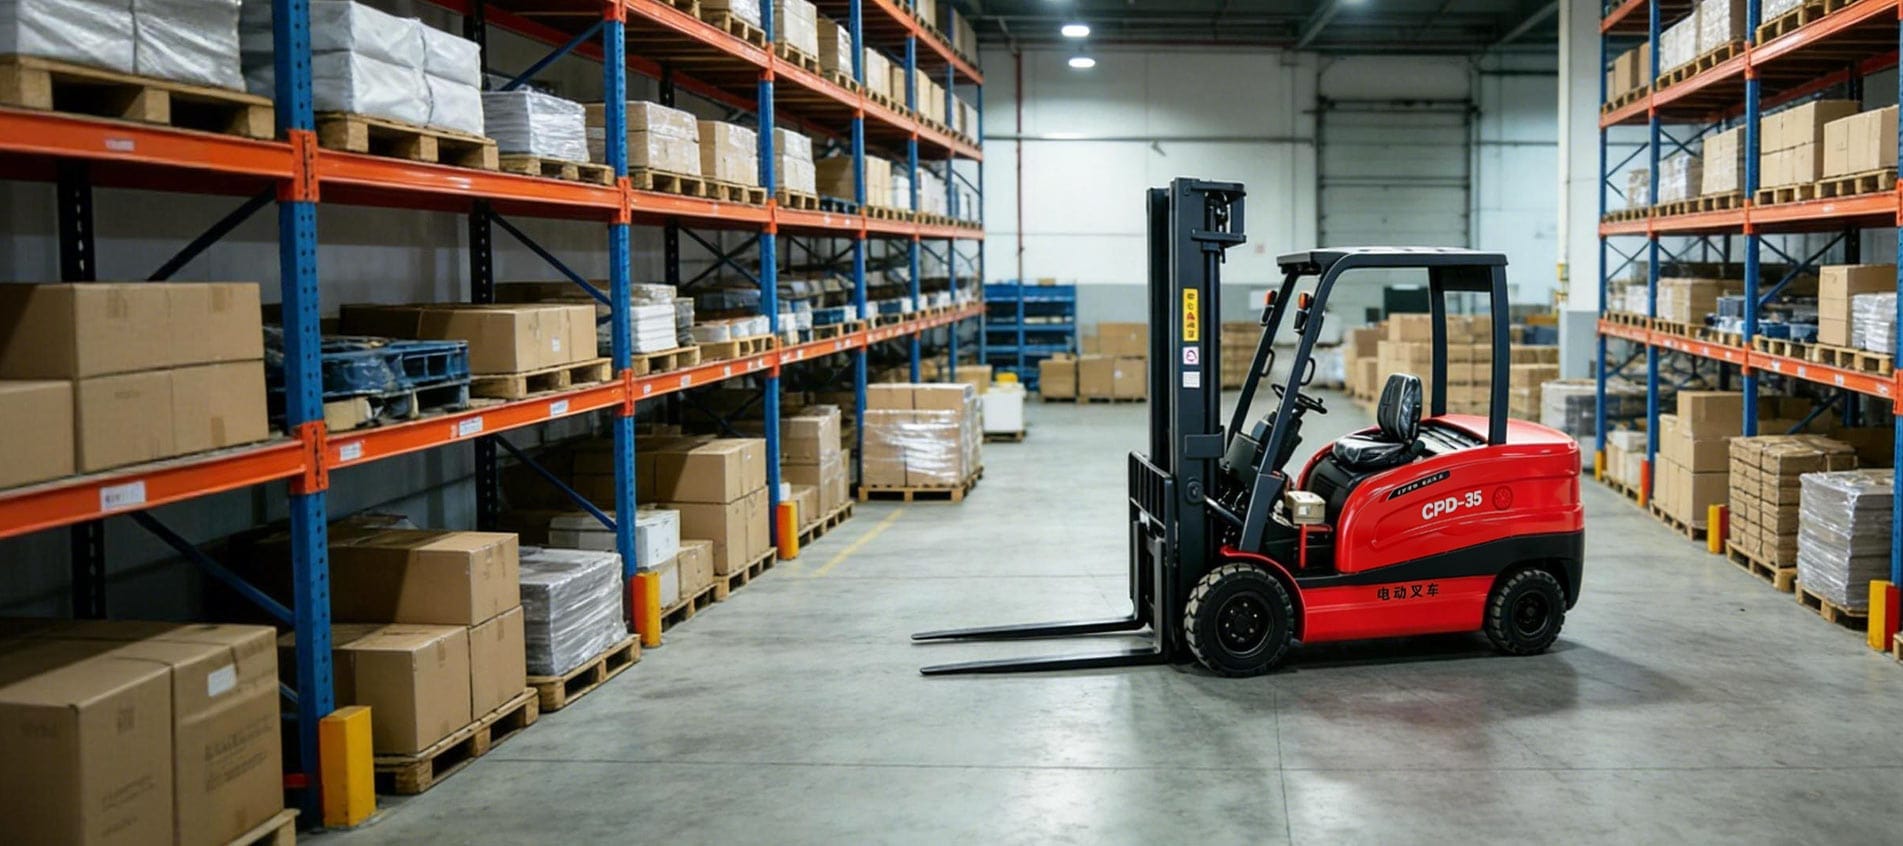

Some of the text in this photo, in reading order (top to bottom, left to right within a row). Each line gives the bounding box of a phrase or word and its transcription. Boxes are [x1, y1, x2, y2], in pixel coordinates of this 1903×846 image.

[1422, 490, 1482, 520] CPD-35
[1377, 583, 1439, 600] 电动叉车
